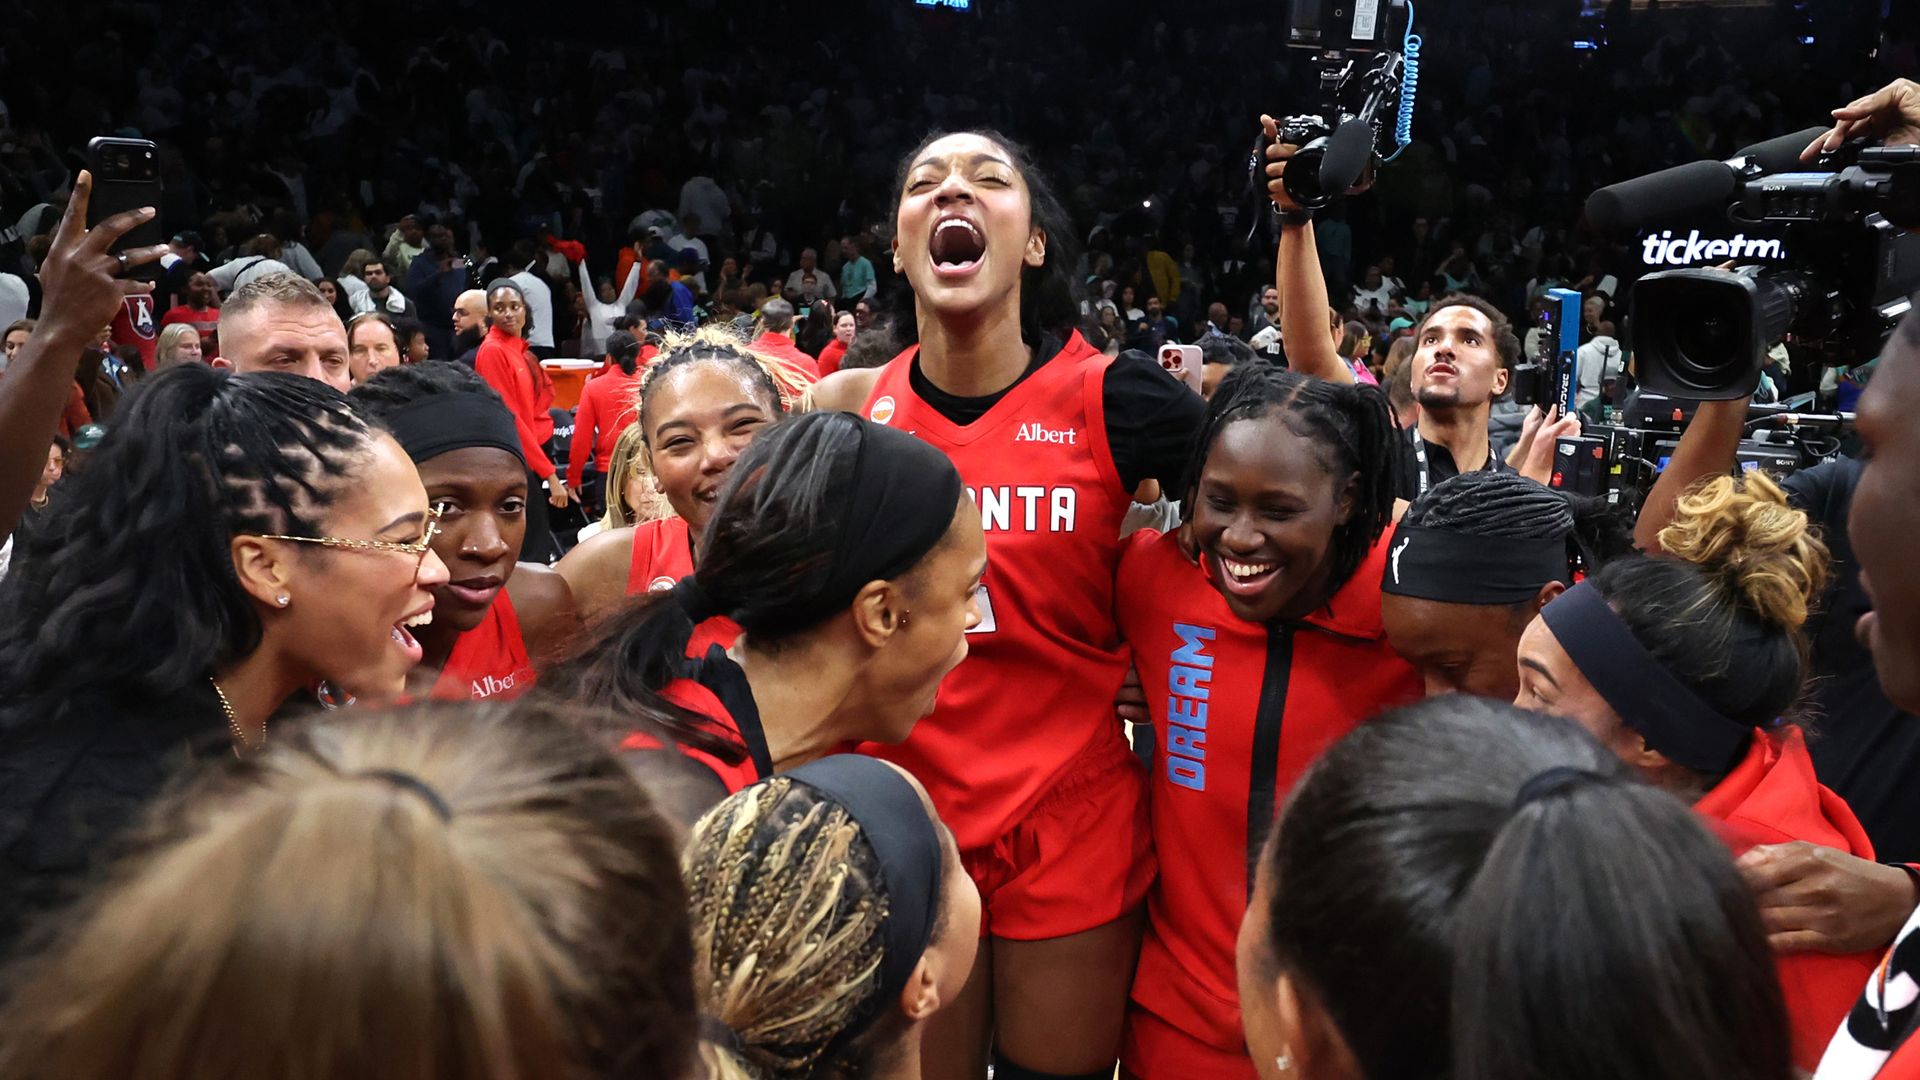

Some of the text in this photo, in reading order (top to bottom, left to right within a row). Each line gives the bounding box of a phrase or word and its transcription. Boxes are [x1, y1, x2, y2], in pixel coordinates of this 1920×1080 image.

[1642, 229, 1786, 265] ticketm
[1015, 423, 1076, 444] Albert
[966, 486, 1077, 532] NTA
[471, 672, 516, 700] Alber
[1167, 622, 1217, 792] DREAM
